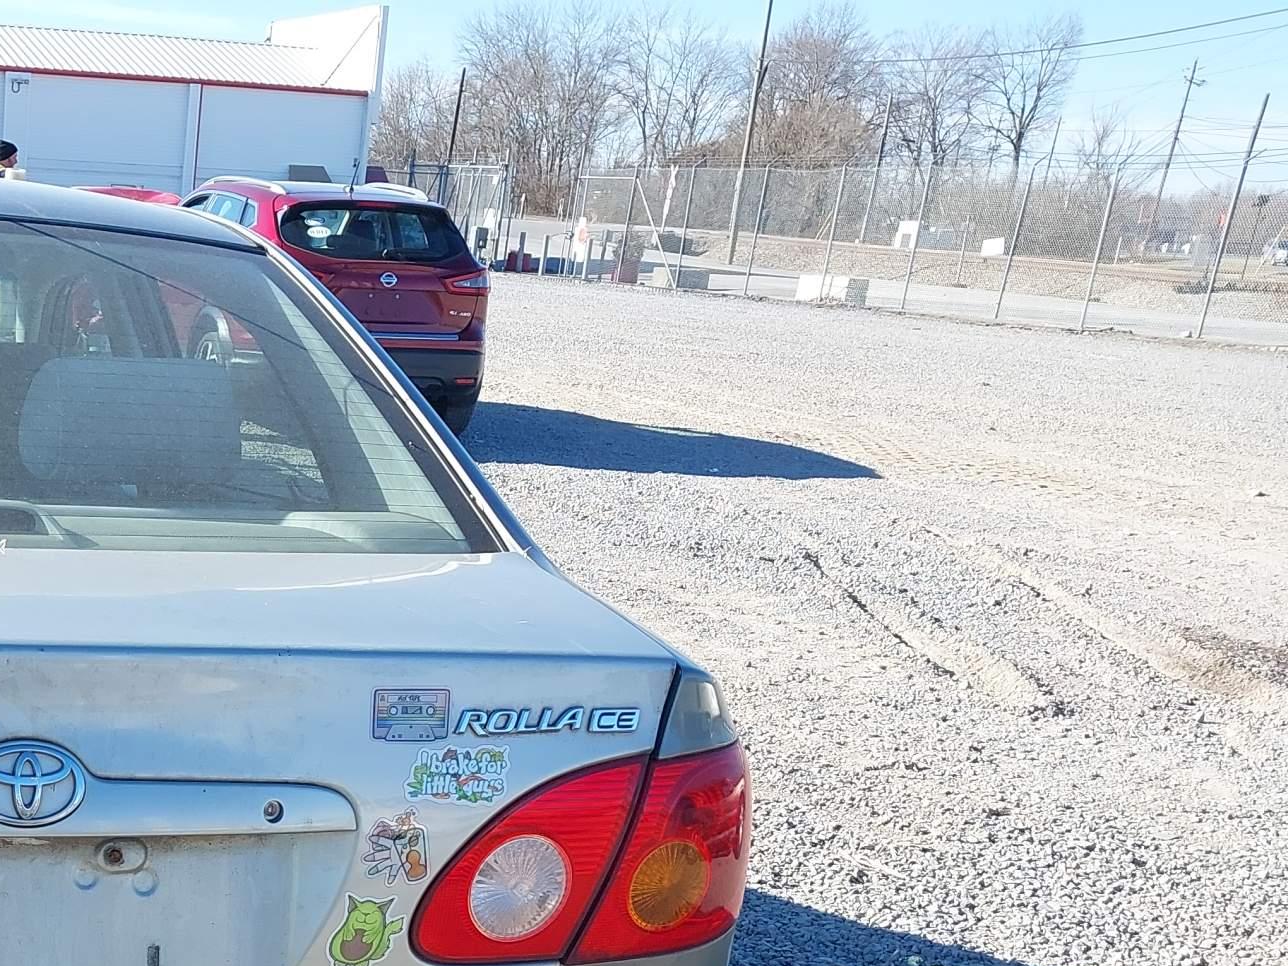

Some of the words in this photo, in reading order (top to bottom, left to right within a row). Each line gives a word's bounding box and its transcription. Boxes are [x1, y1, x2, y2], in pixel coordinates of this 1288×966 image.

[453, 706, 585, 737] ROLLA
[594, 709, 638, 730] CE
[431, 752, 478, 775] brake
[478, 752, 507, 775] for
[422, 774, 458, 795] little
[462, 778, 505, 799] guys
